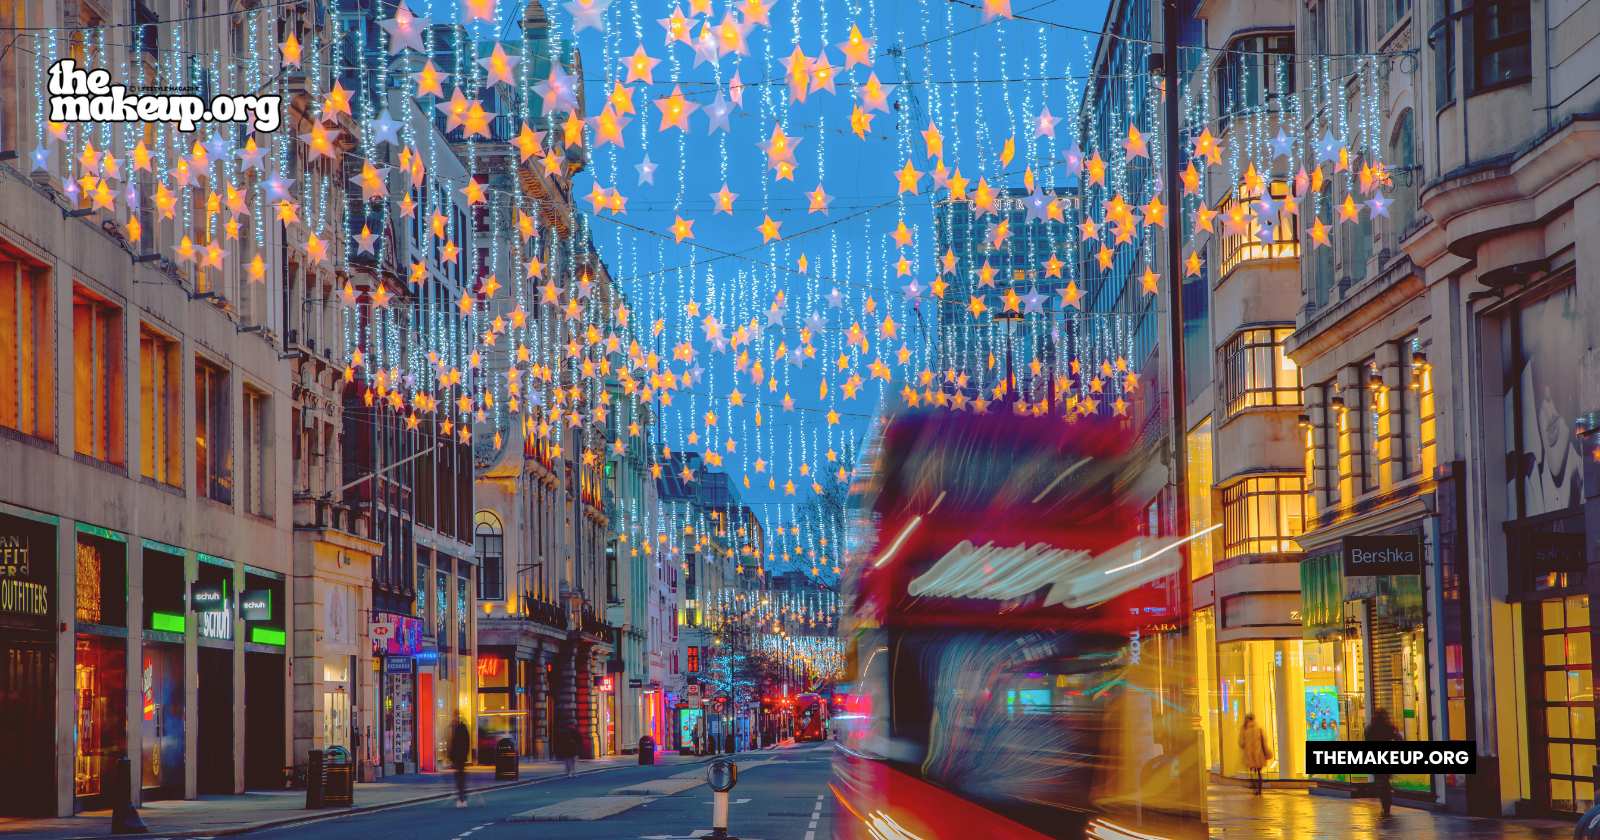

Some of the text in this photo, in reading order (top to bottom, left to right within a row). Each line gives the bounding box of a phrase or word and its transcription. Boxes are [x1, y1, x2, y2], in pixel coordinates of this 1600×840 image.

[1351, 548, 1414, 563] Bershka
[1, 579, 48, 614] OUTFITTERS
[195, 592, 220, 600] schuh
[244, 601, 265, 609] schuh
[1144, 623, 1177, 631] ZARA
